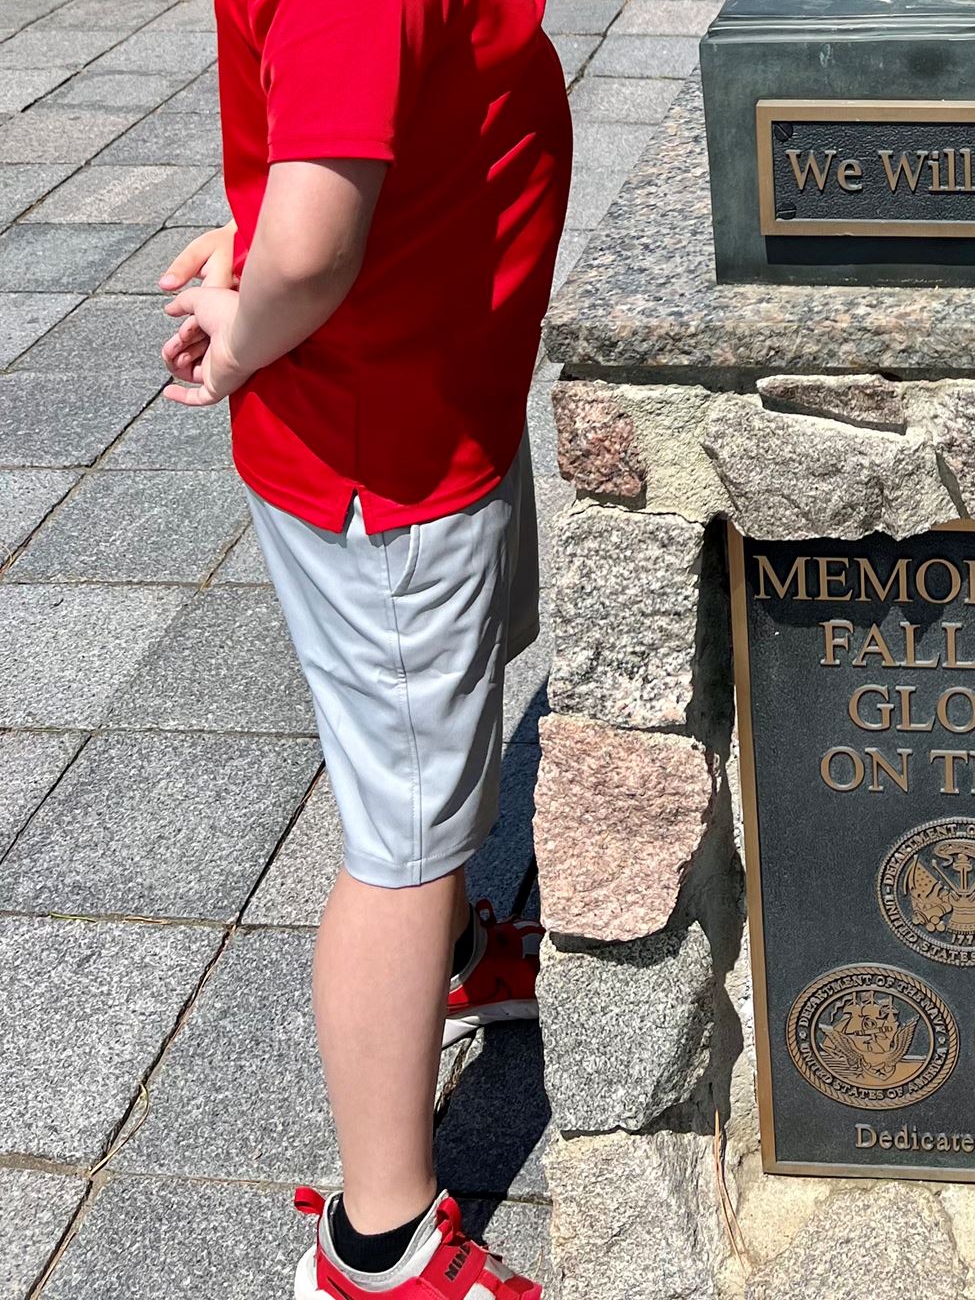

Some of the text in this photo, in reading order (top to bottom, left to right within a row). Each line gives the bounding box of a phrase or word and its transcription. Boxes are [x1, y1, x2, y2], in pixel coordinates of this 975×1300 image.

[785, 149, 863, 192] We
[878, 148, 975, 193] Will
[820, 745, 912, 793] ON
[875, 975, 895, 988] OF
[897, 981, 923, 1000] THE
[921, 999, 946, 1034] NAVY
[833, 1081, 884, 1100] STATES
[887, 1089, 903, 1098] OF
